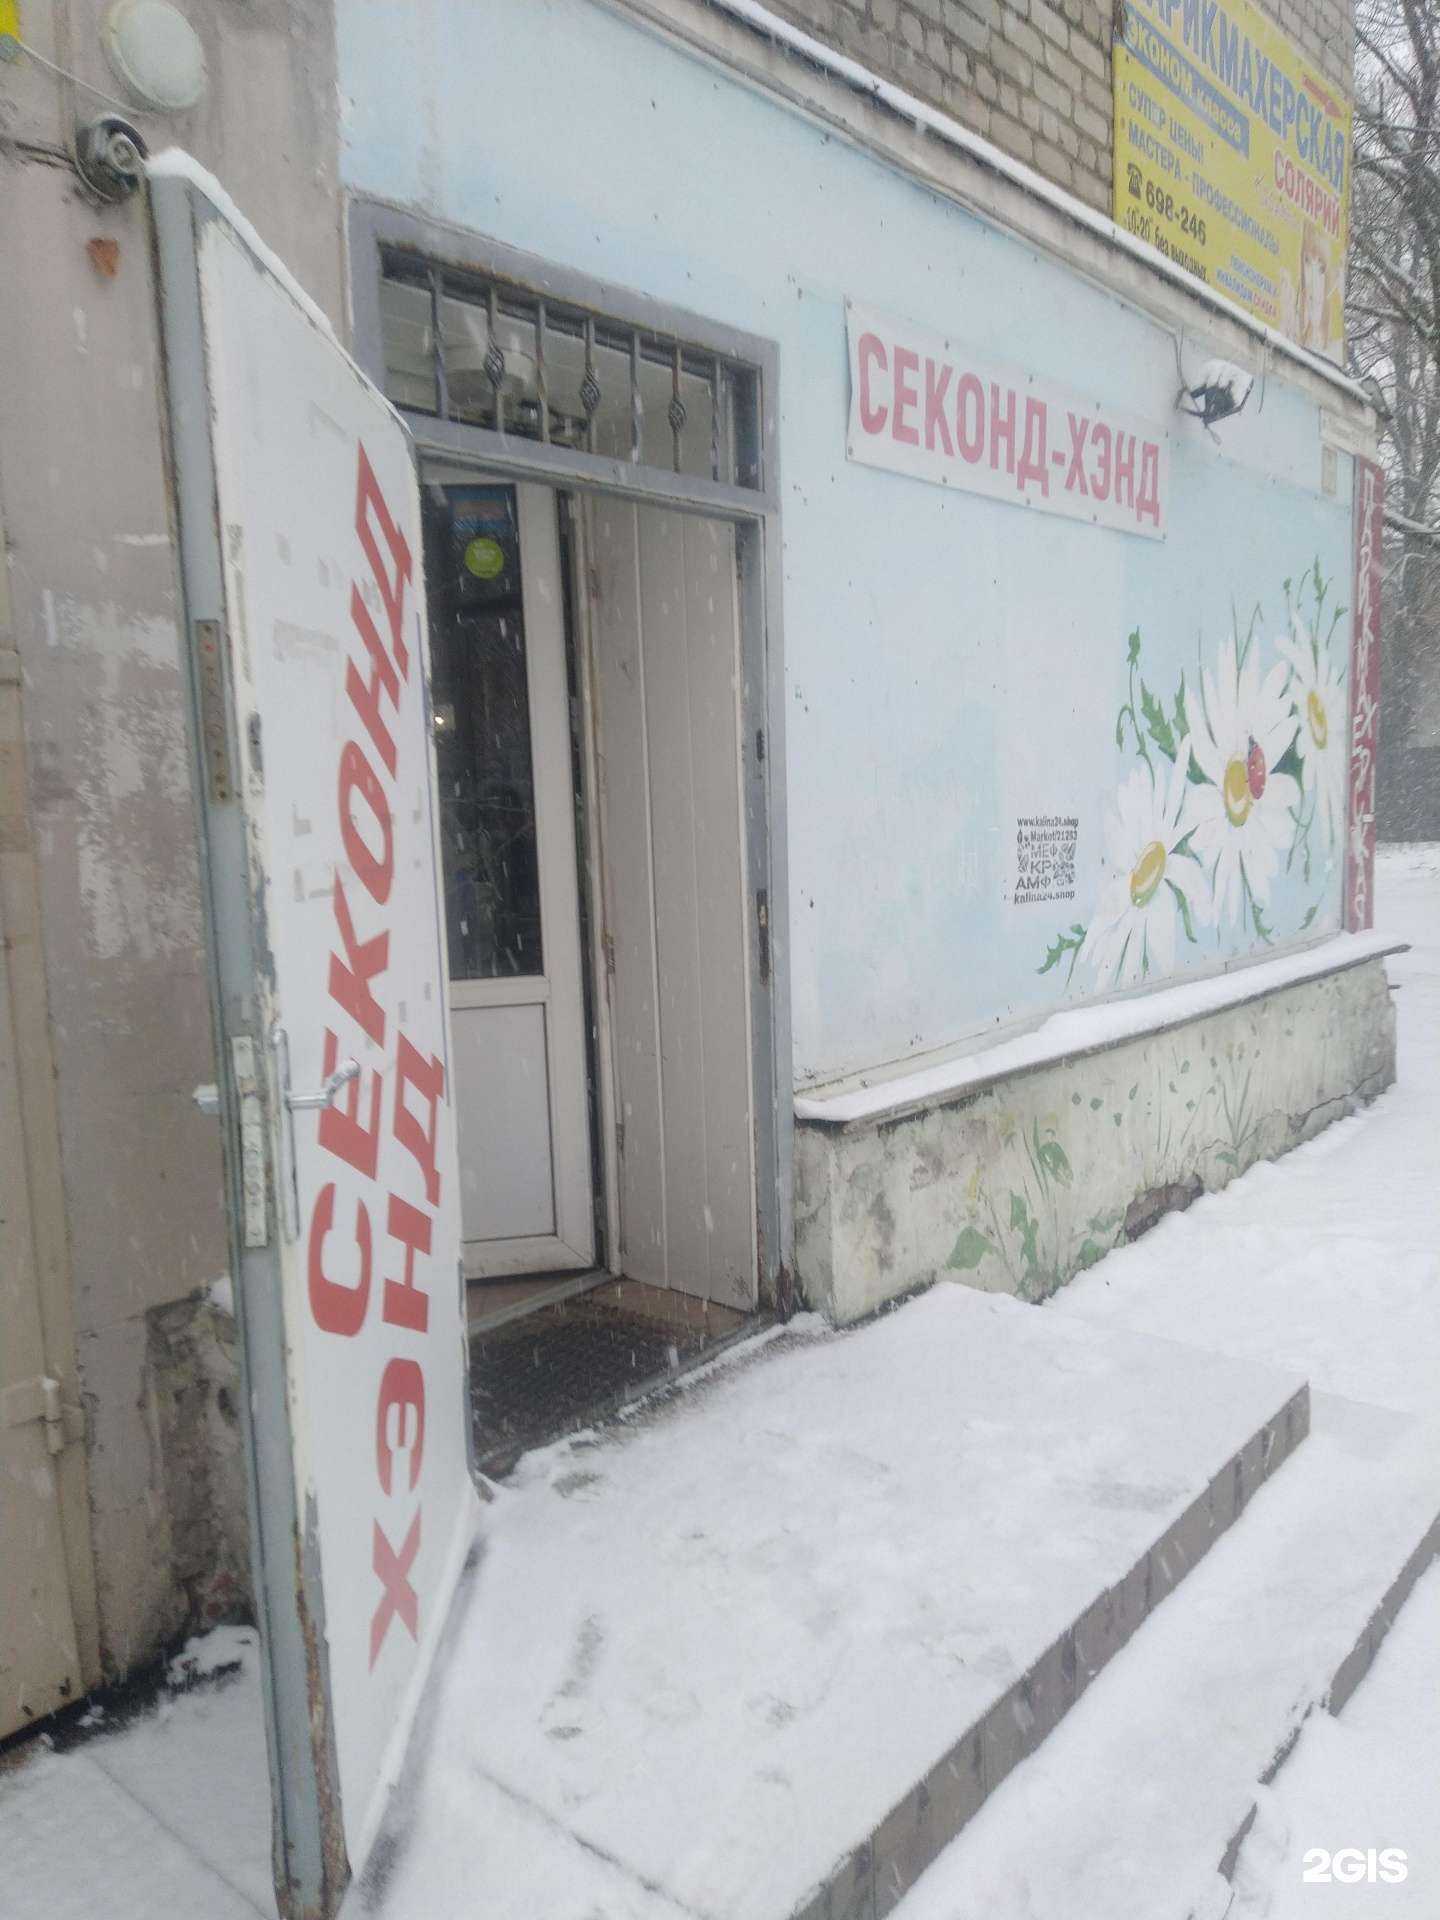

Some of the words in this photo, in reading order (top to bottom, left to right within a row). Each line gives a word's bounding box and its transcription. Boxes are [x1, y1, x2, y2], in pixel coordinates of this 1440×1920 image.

[1128, 119, 1182, 182] МАСТЕРА
[1145, 180, 1207, 247] 698-246
[1273, 149, 1340, 238] СОЛЯРИЙ
[857, 331, 1160, 528] СЕКОНД-ХЭНД
[307, 438, 413, 1338] СЕКОНД
[367, 1031, 445, 1675] ХЭНД
